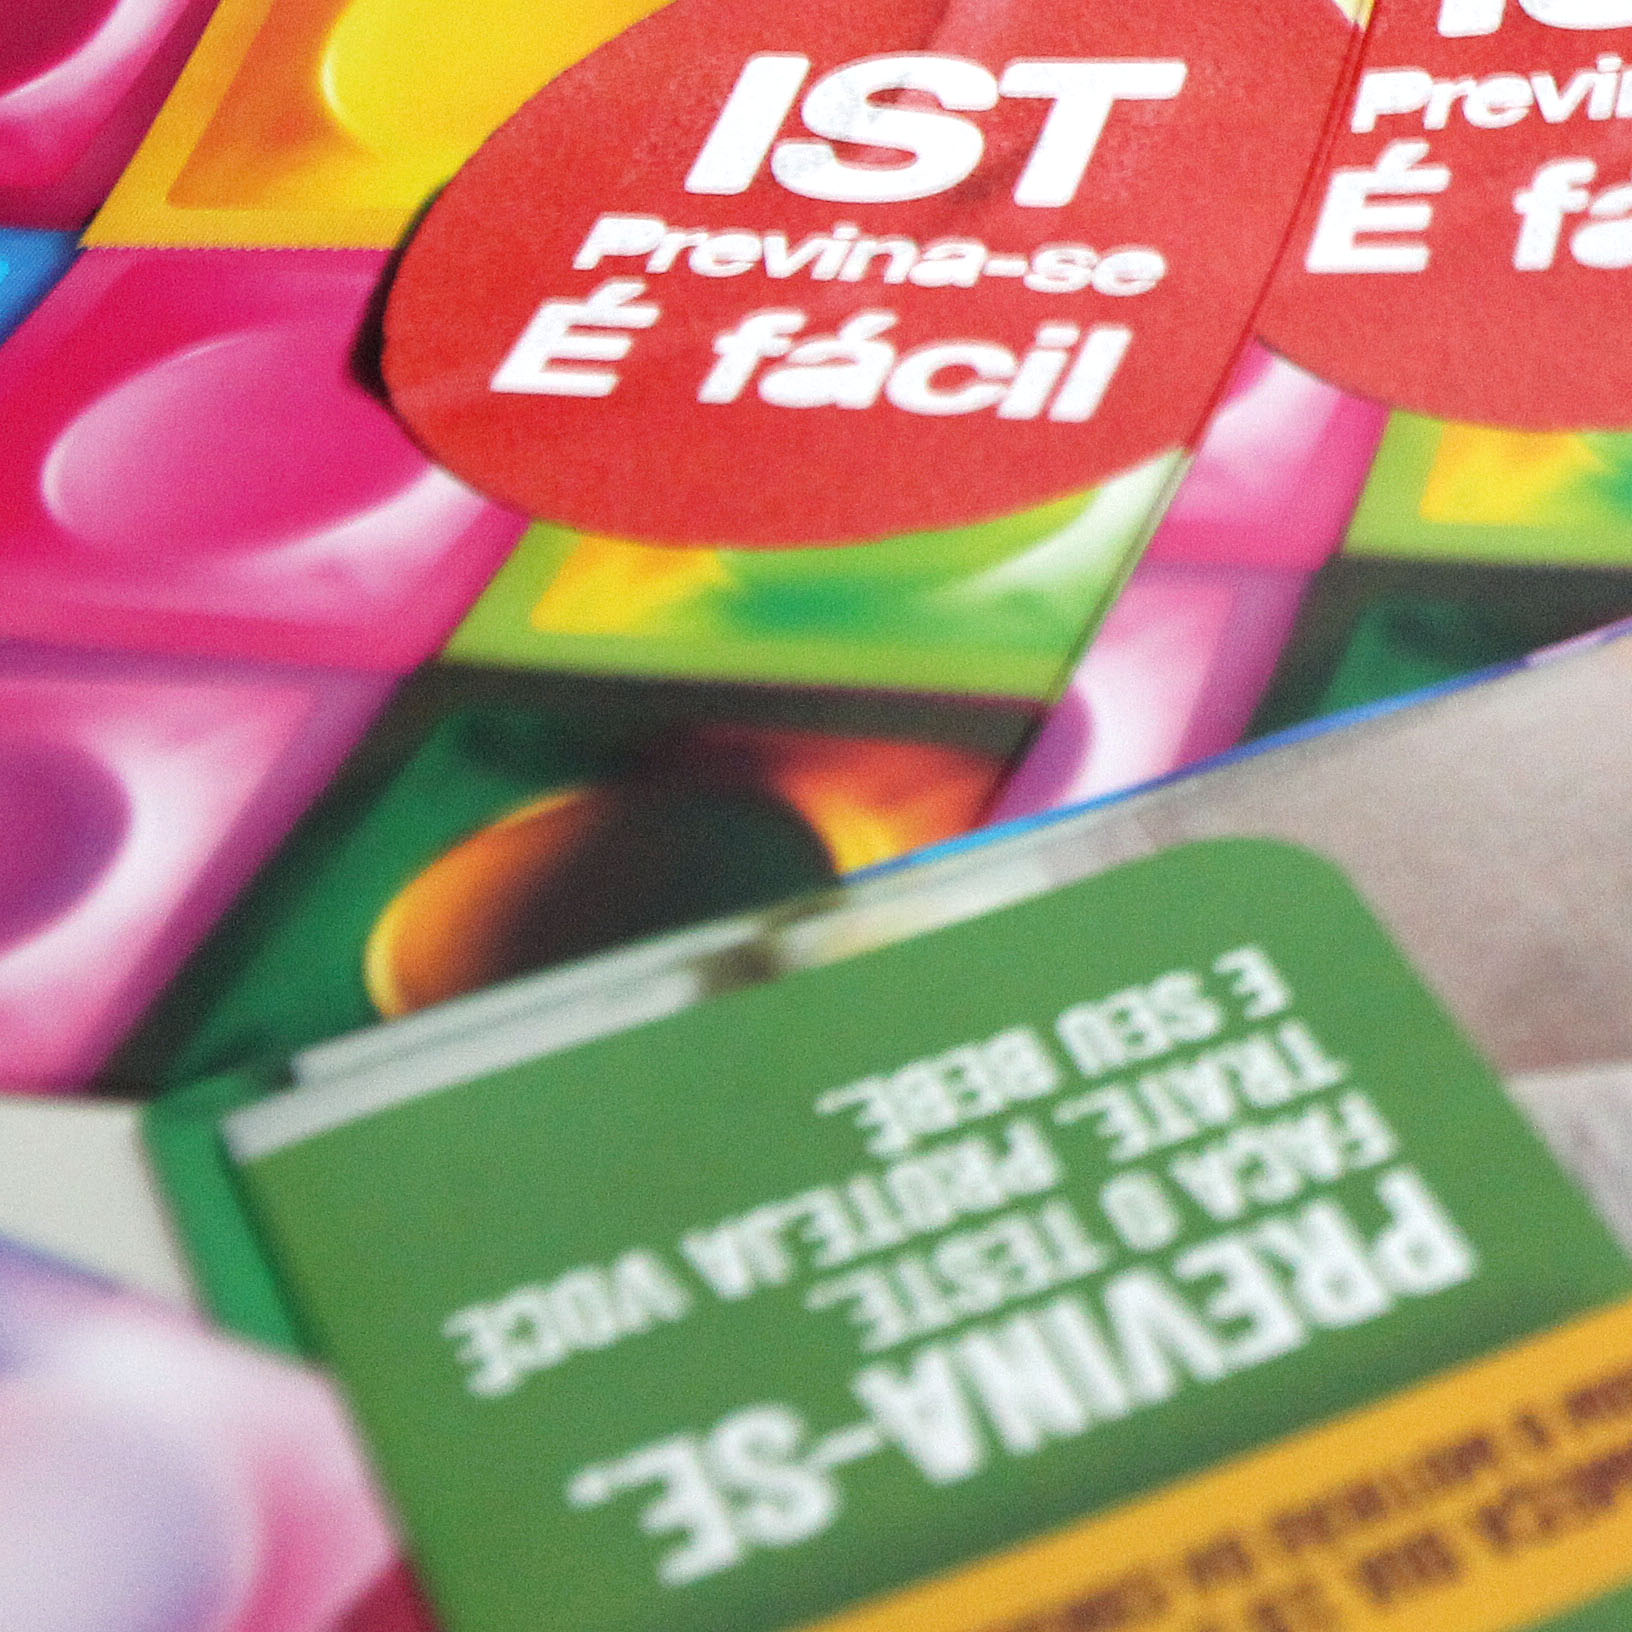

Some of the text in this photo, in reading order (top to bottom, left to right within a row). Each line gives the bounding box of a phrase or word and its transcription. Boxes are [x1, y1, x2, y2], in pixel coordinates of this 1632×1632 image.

[683, 52, 1188, 209] IST
[572, 212, 1167, 298] Previna-se
[1304, 140, 1452, 275] É
[489, 278, 1133, 423] É fácil
[1055, 969, 1226, 1077] SEU
[1213, 944, 1293, 1020] E
[679, 1115, 1062, 1301] PROTEJA
[1101, 1168, 1181, 1253] O
[1167, 1089, 1400, 1223] FAÇA
[566, 1164, 1477, 1588] PREVINA-SE.
